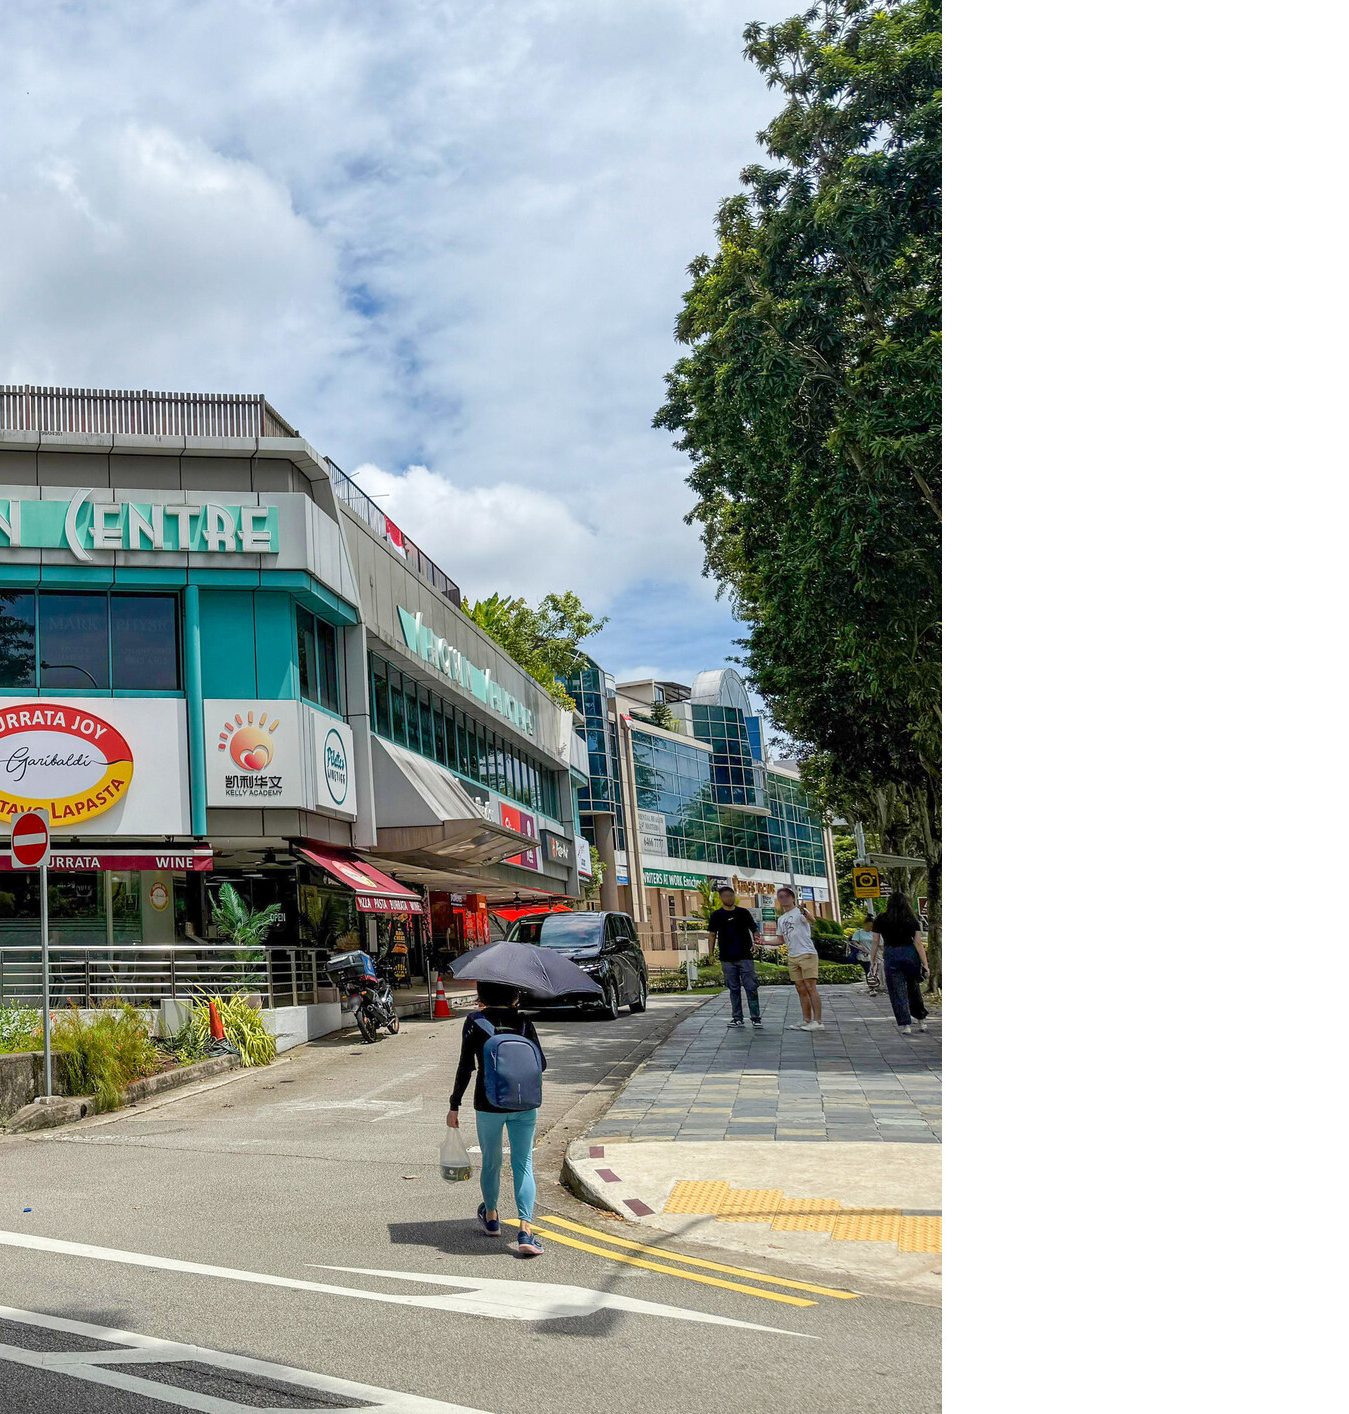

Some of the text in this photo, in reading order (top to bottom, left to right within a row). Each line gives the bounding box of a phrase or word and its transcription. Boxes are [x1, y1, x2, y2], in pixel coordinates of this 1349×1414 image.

[64, 488, 271, 562] CENTRE
[71, 716, 107, 740] JOY
[6, 747, 92, 782] Garibaldi
[225, 775, 283, 789] 凯利华文
[50, 778, 125, 819] LAPASTA
[46, 856, 101, 869] URRATA
[155, 856, 194, 869] WINE
